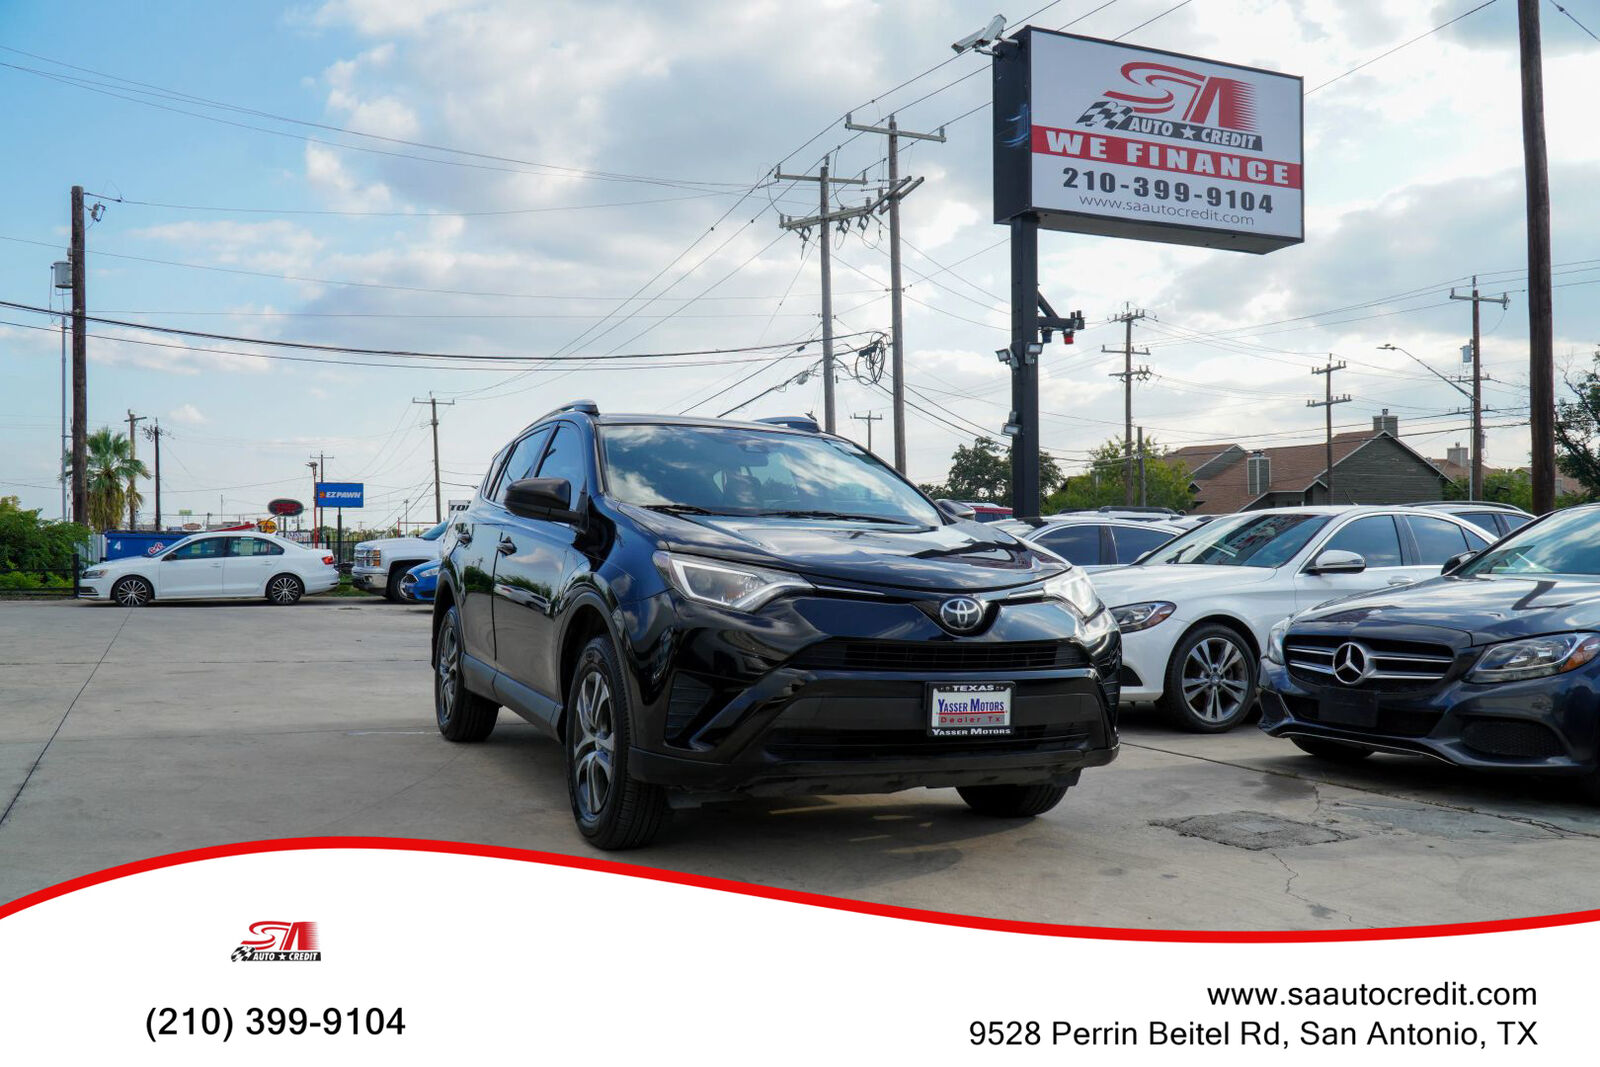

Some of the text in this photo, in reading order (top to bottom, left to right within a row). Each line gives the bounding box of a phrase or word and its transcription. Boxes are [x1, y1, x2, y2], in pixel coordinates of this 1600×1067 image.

[1129, 118, 1257, 151] AUTO CREDIT
[1045, 130, 1290, 185] WE FINANCE
[1062, 167, 1274, 214] 210-399-9104
[1079, 194, 1254, 226] www.saautocredit.com
[938, 698, 1004, 713] YASSER MOTORS
[932, 728, 968, 736] YASSER
